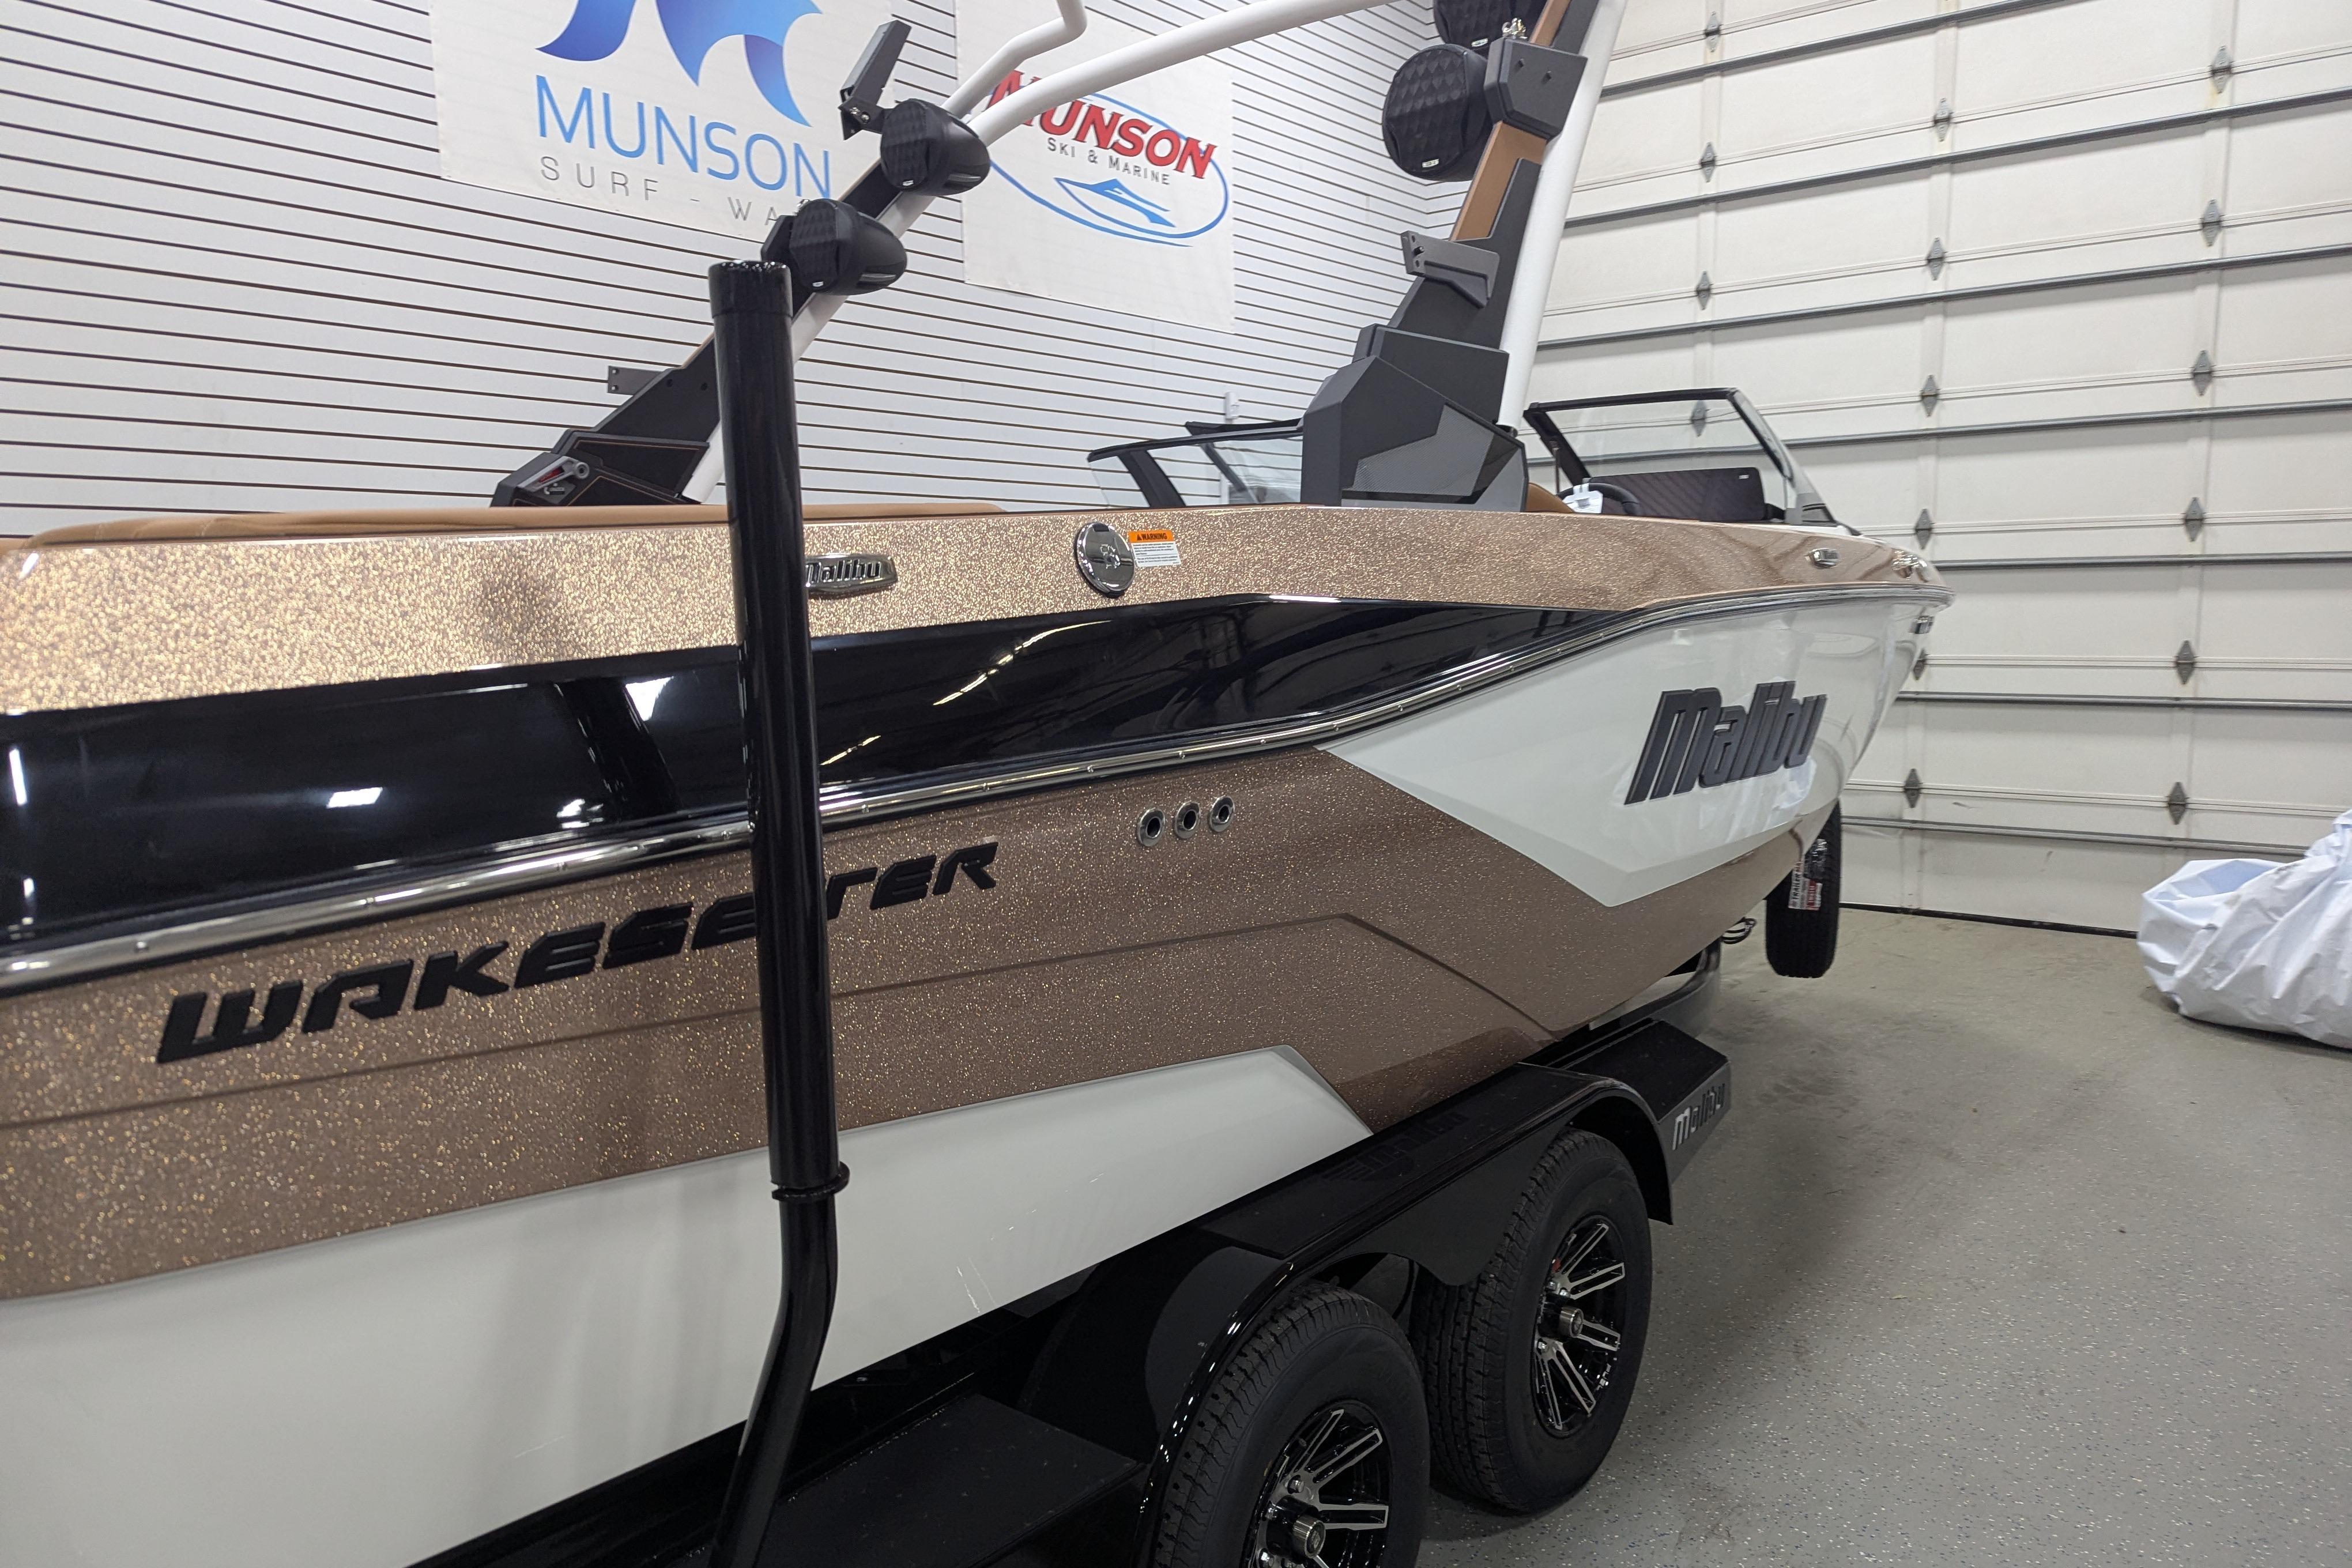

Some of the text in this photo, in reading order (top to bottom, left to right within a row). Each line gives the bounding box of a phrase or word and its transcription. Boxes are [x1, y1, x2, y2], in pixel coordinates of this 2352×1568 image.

[536, 74, 831, 199] MUNSON
[540, 155, 658, 201] SURF
[1047, 137, 1170, 186] SKI & MARINE
[1624, 680, 1827, 805] Malibu
[156, 842, 998, 1064] WAKESETER
